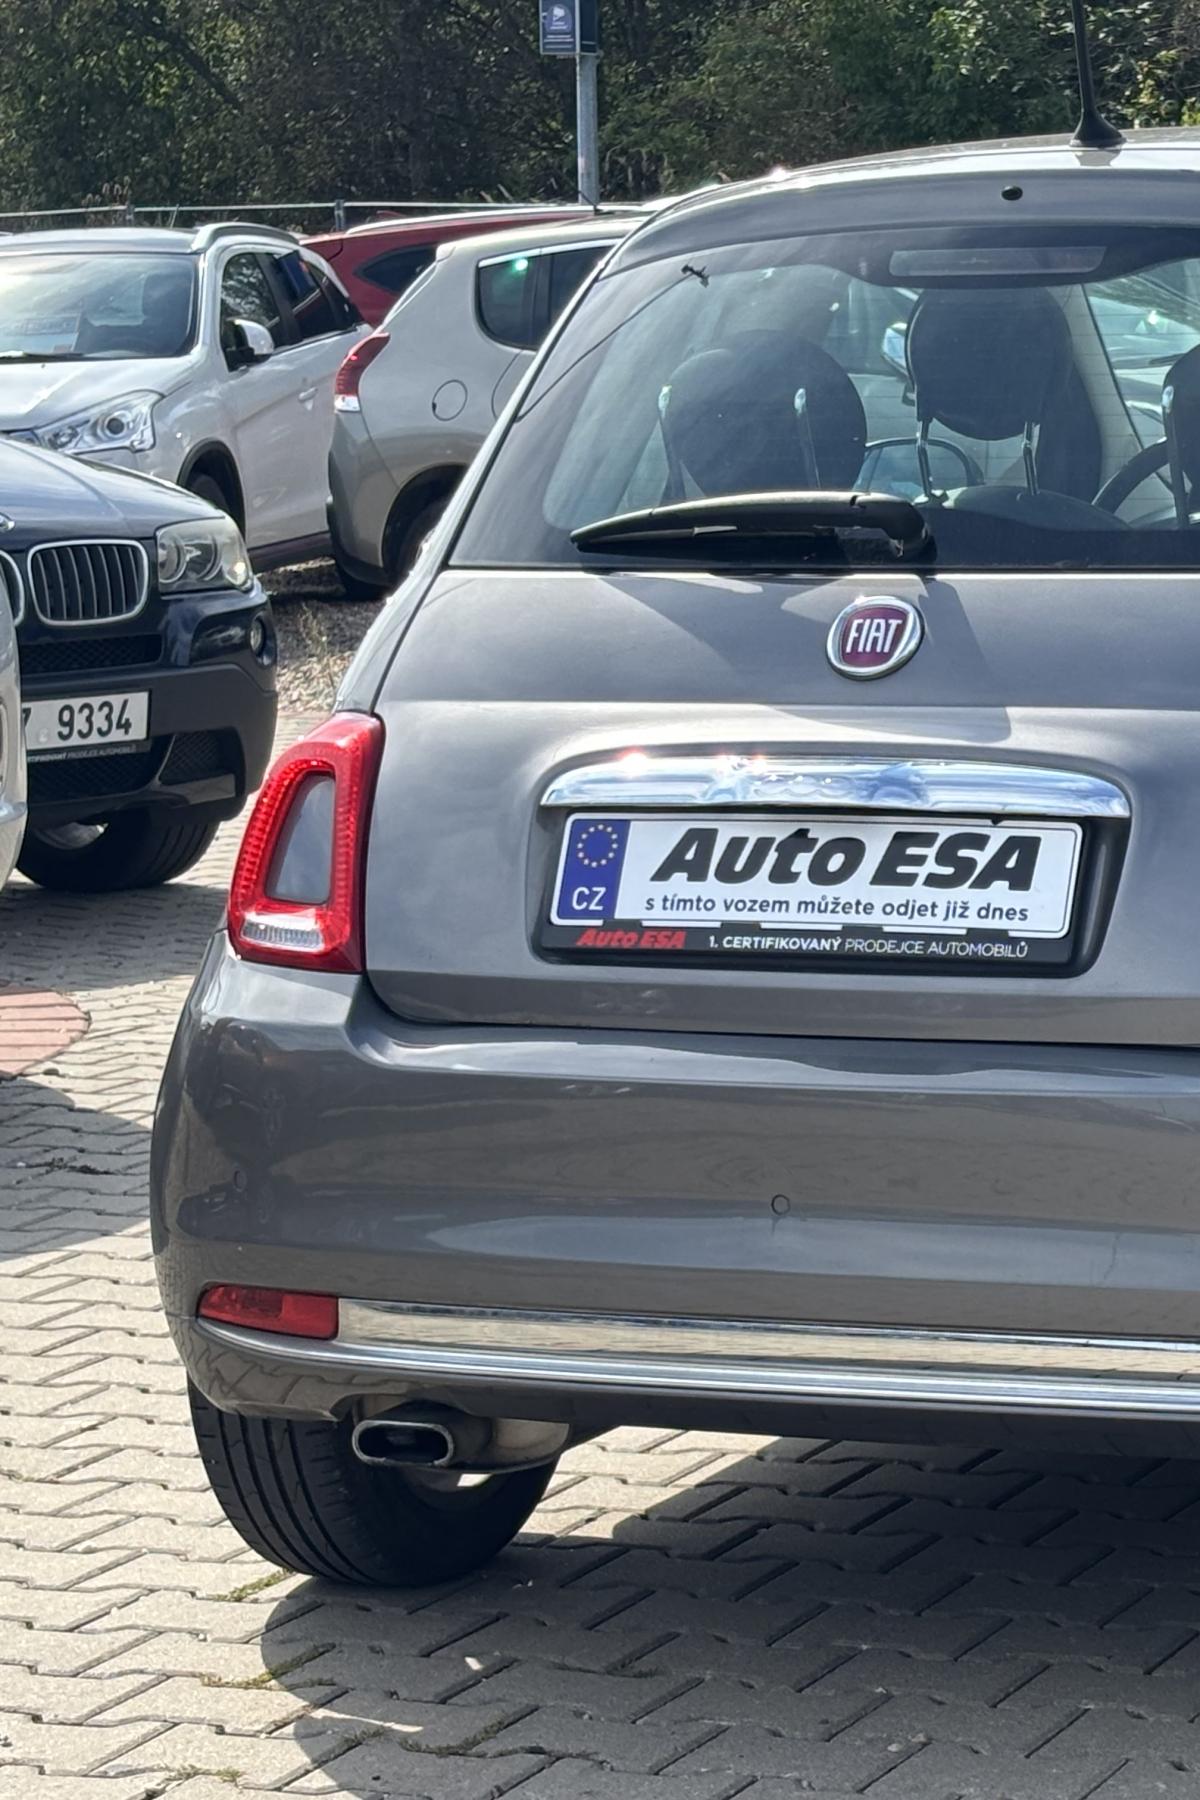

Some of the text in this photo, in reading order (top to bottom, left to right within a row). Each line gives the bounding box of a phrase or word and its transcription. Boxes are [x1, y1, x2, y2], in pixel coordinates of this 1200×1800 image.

[845, 618, 903, 654] FIAT
[57, 698, 132, 741] 9334
[649, 827, 1042, 892] Auto ESA
[571, 886, 607, 911] CZ
[644, 894, 1029, 922] s tímto vozem můžete odjet již dnes
[576, 927, 686, 949] Auto ESA
[709, 935, 1028, 958] 1. CERTIFIKOVANÝ PRODEJCE AUTOMOBILŮ
